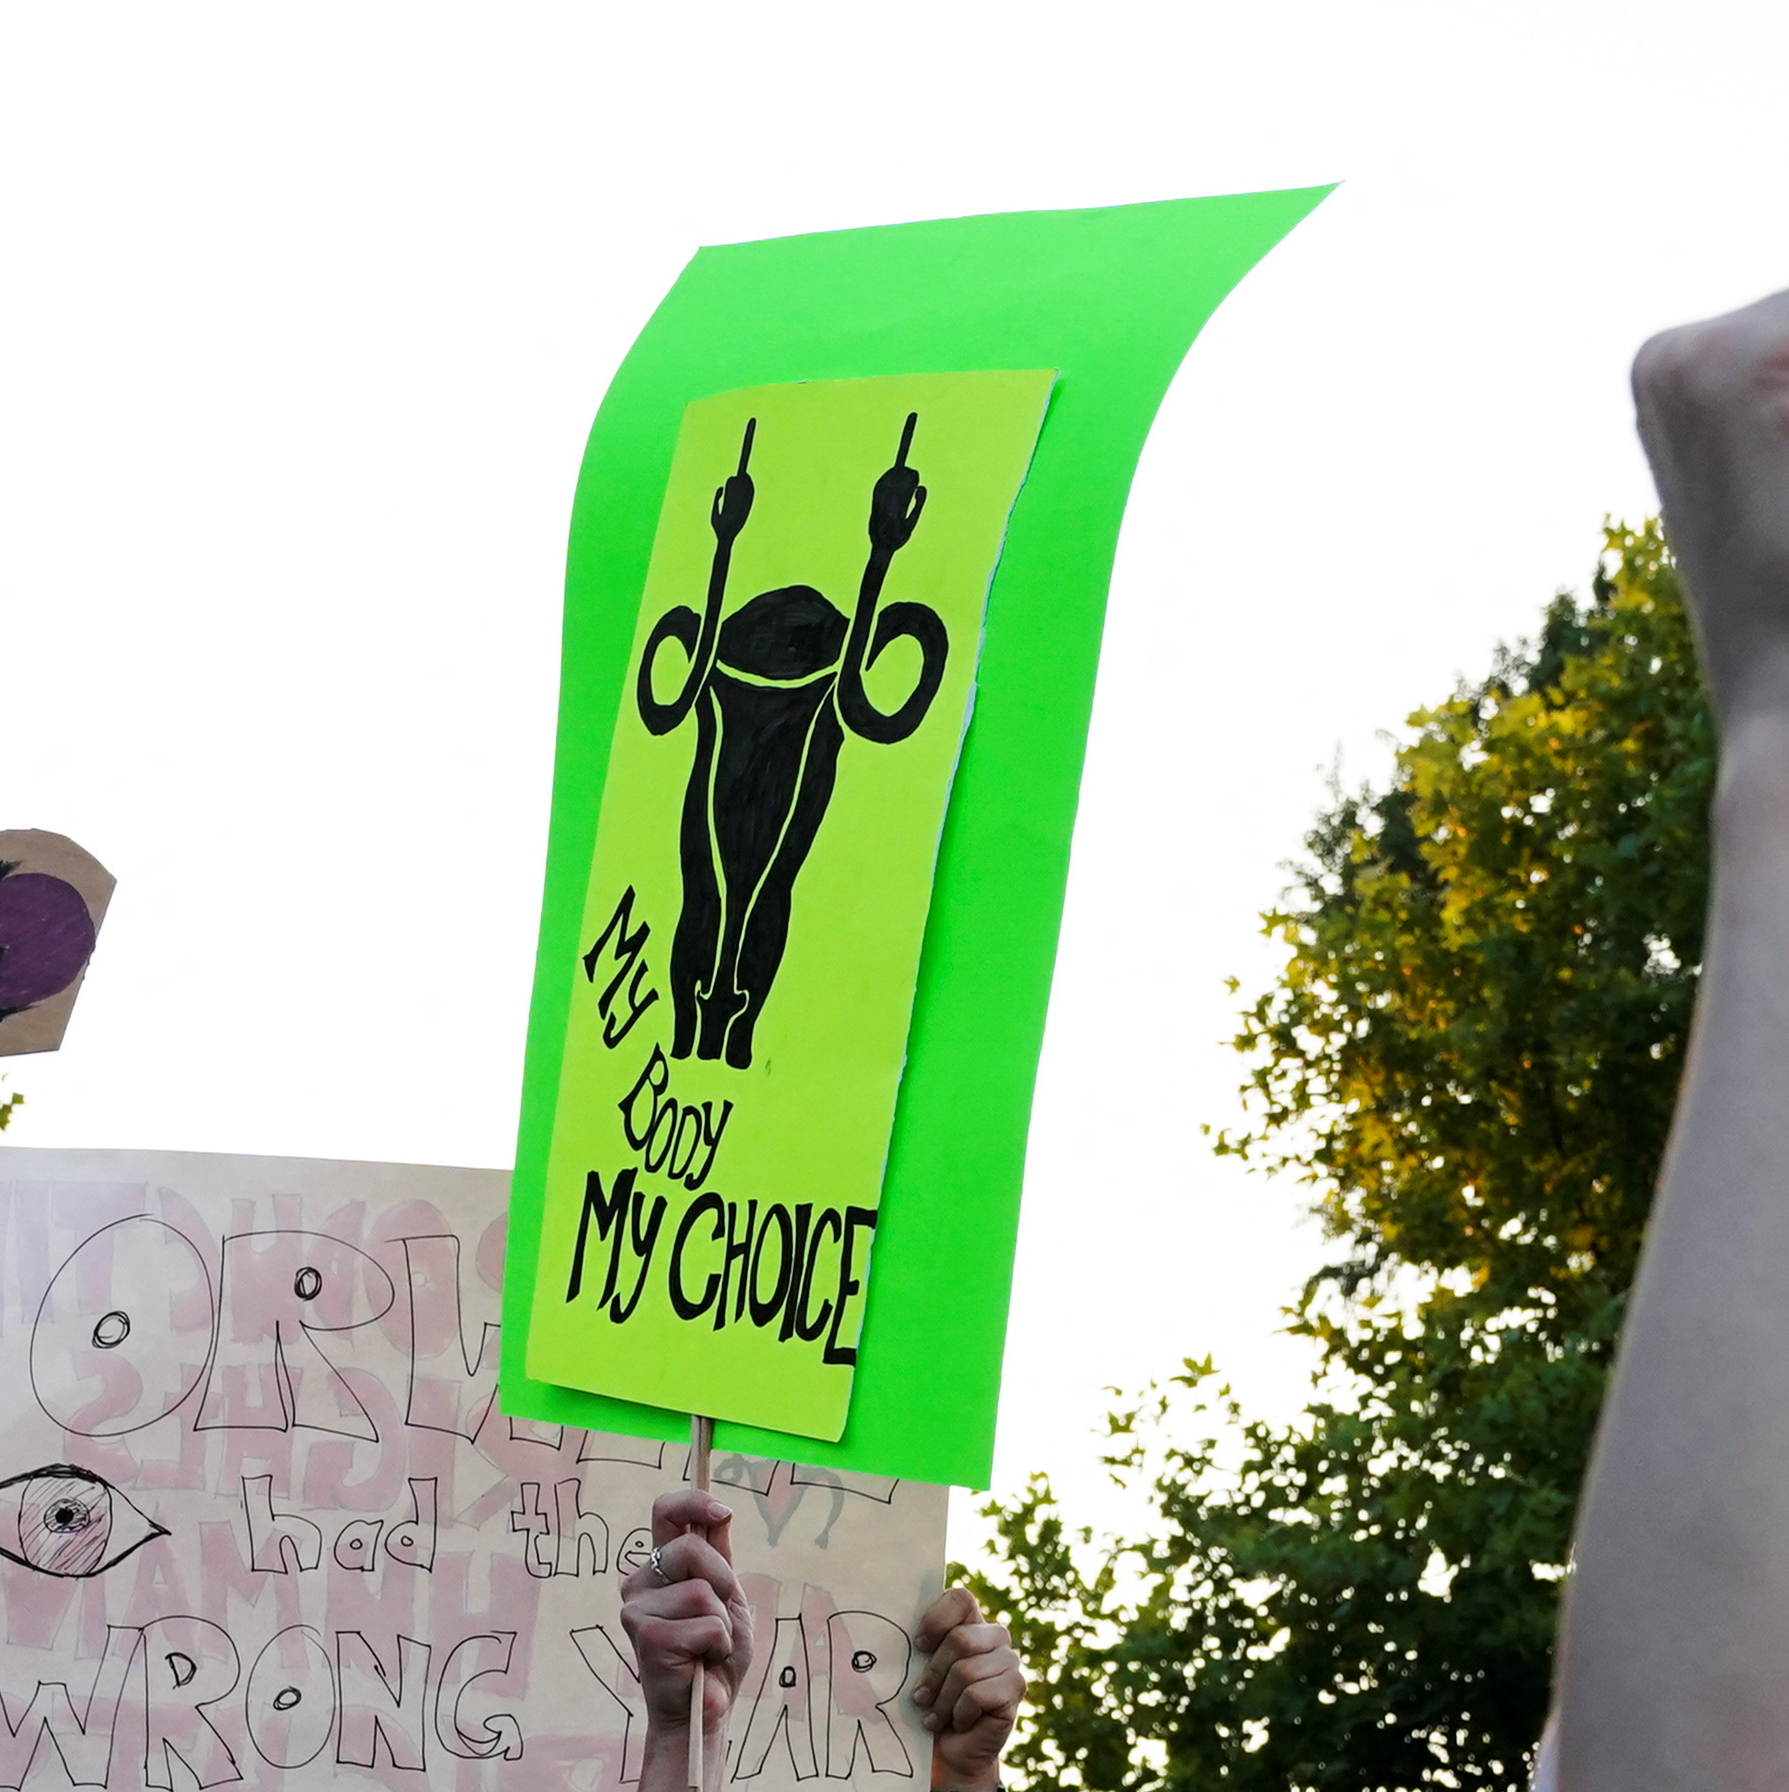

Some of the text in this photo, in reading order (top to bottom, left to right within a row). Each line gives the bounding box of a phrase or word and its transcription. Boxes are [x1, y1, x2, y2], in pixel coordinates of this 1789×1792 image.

[668, 1192, 878, 1366] CHOICE
[240, 1474, 438, 1574] had
[570, 1610, 914, 1783] YAR
